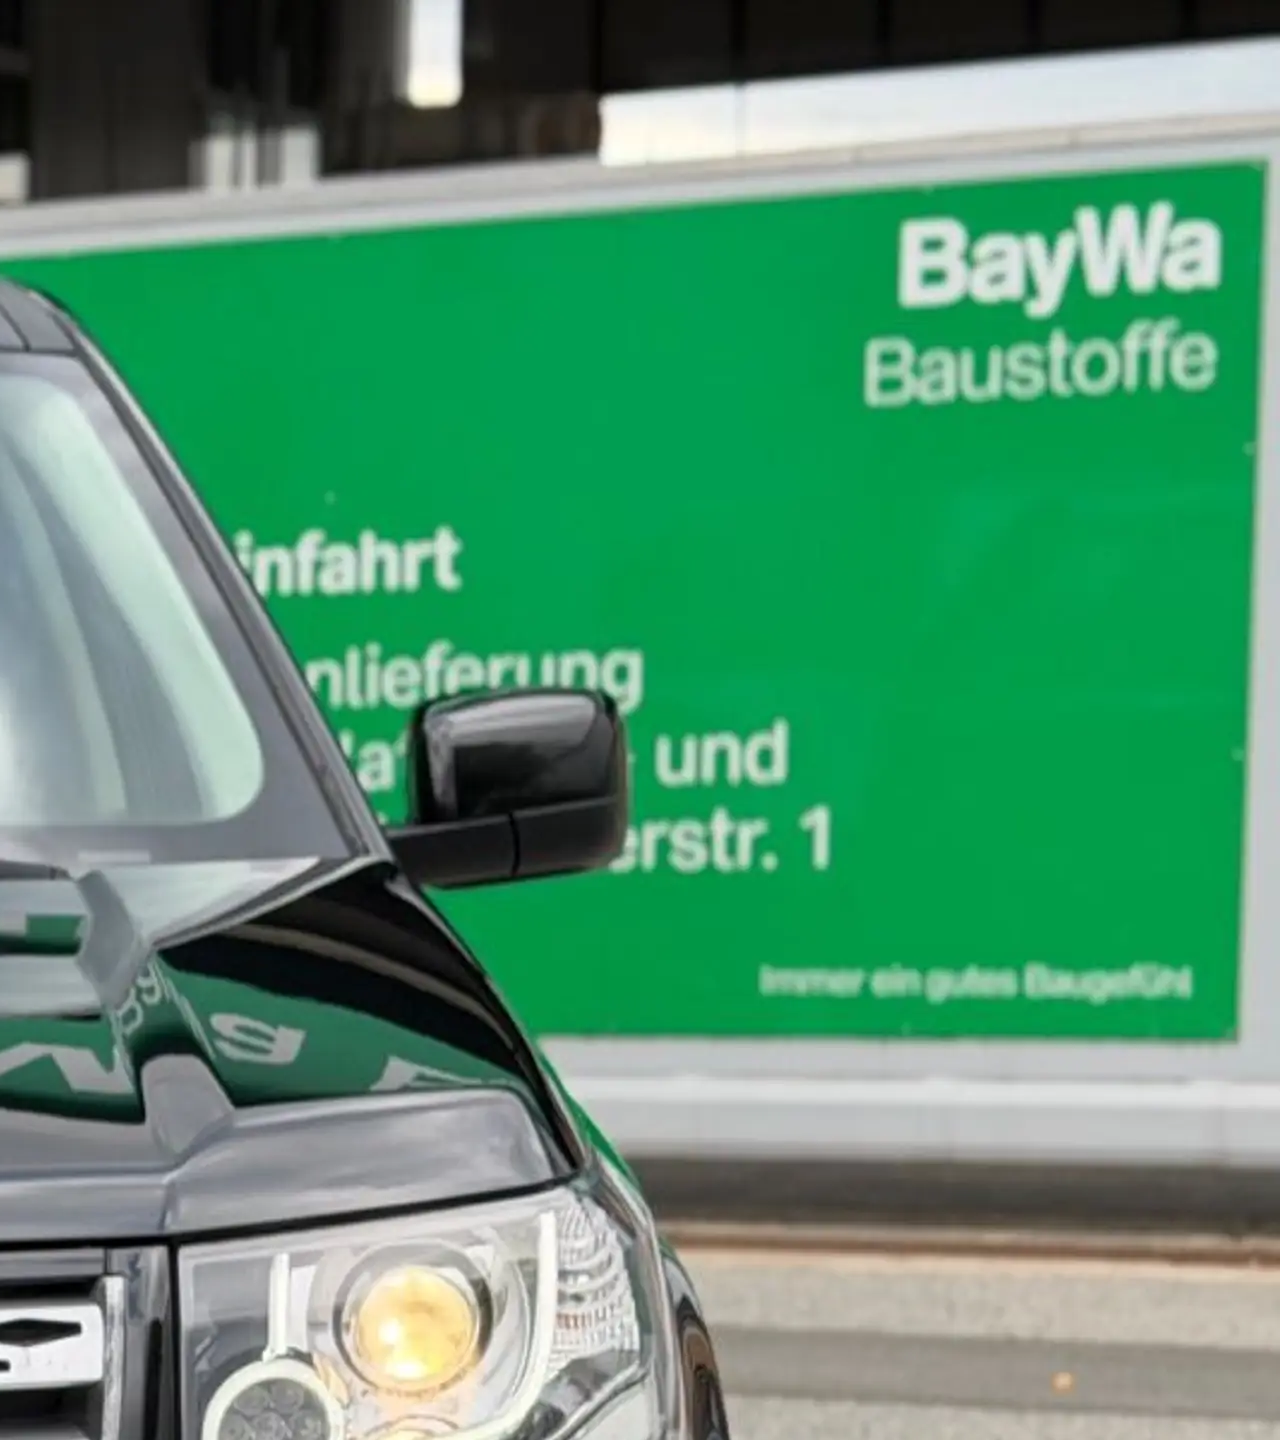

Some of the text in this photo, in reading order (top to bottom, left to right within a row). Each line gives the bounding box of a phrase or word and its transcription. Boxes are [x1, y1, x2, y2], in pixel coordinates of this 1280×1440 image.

[898, 200, 1222, 320] BayWa
[864, 317, 1218, 408] Baustoffe
[233, 525, 462, 597] infahrt
[303, 638, 644, 715] nlieferung
[655, 718, 790, 788] und
[800, 804, 832, 871] 1
